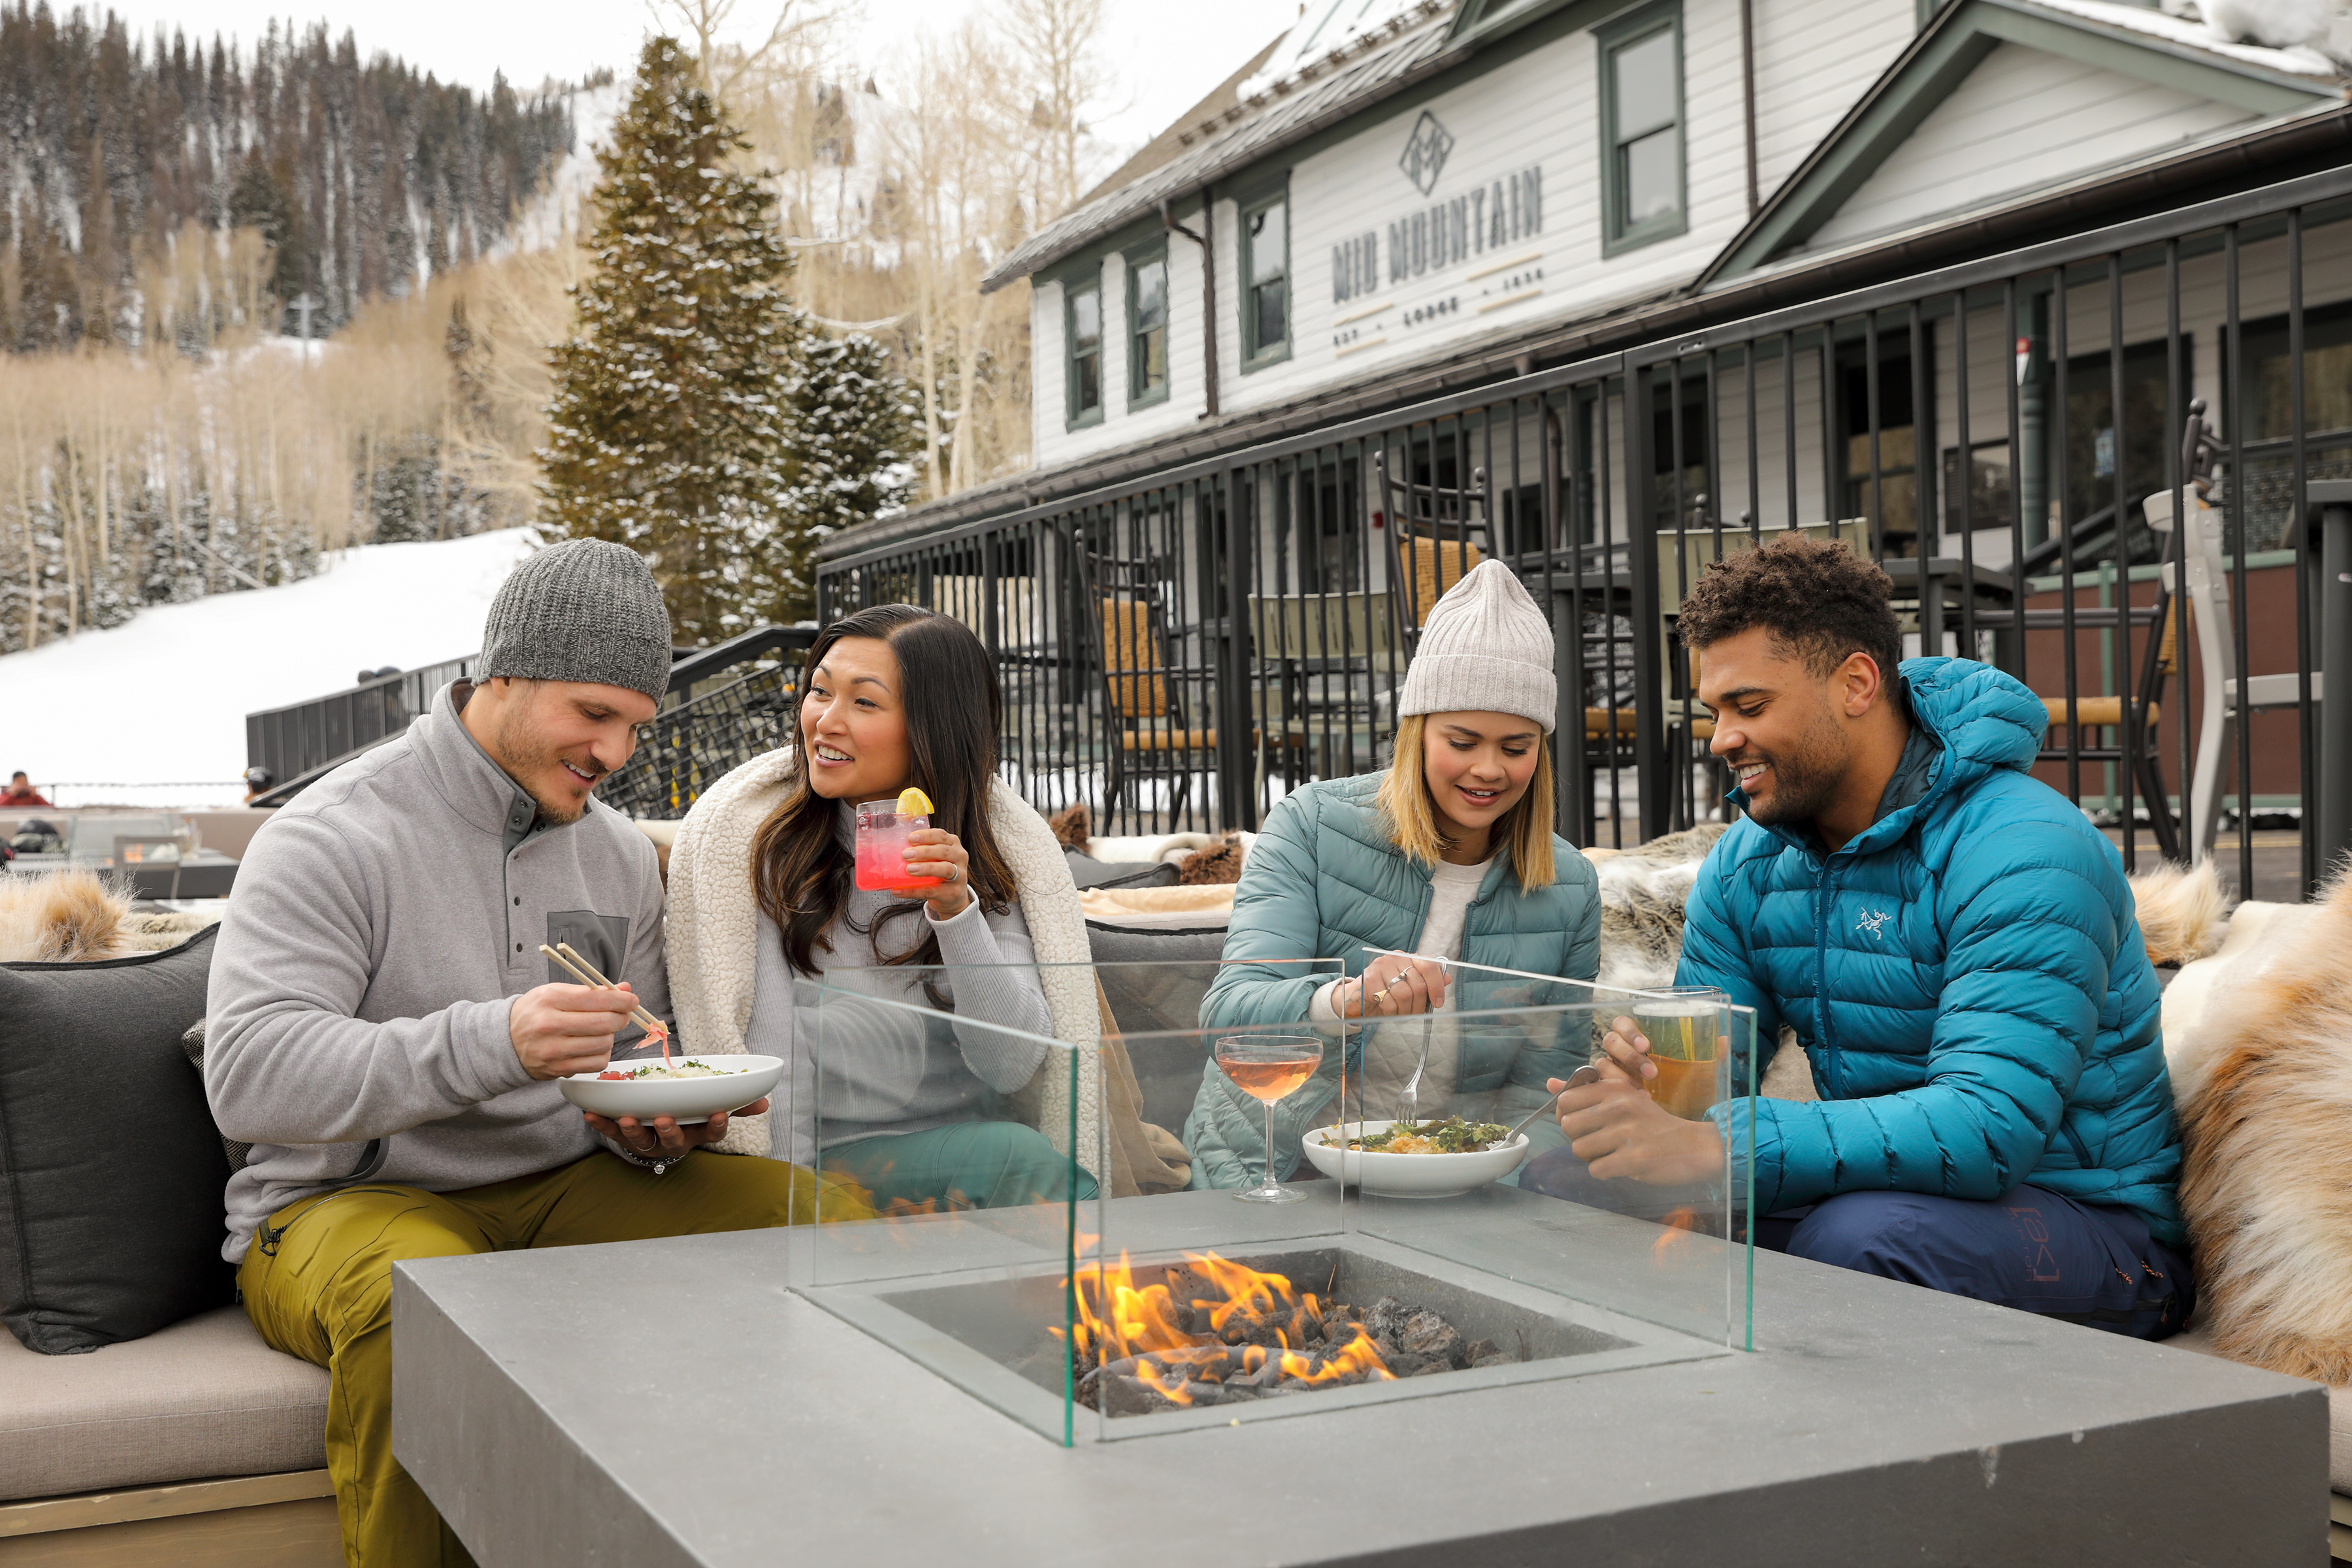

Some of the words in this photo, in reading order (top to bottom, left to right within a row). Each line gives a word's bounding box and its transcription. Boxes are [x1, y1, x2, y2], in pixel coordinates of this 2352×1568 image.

[1332, 231, 1378, 304] MID
[1388, 165, 1543, 284] MOUNTAIN
[1403, 296, 1458, 327] LODGE
